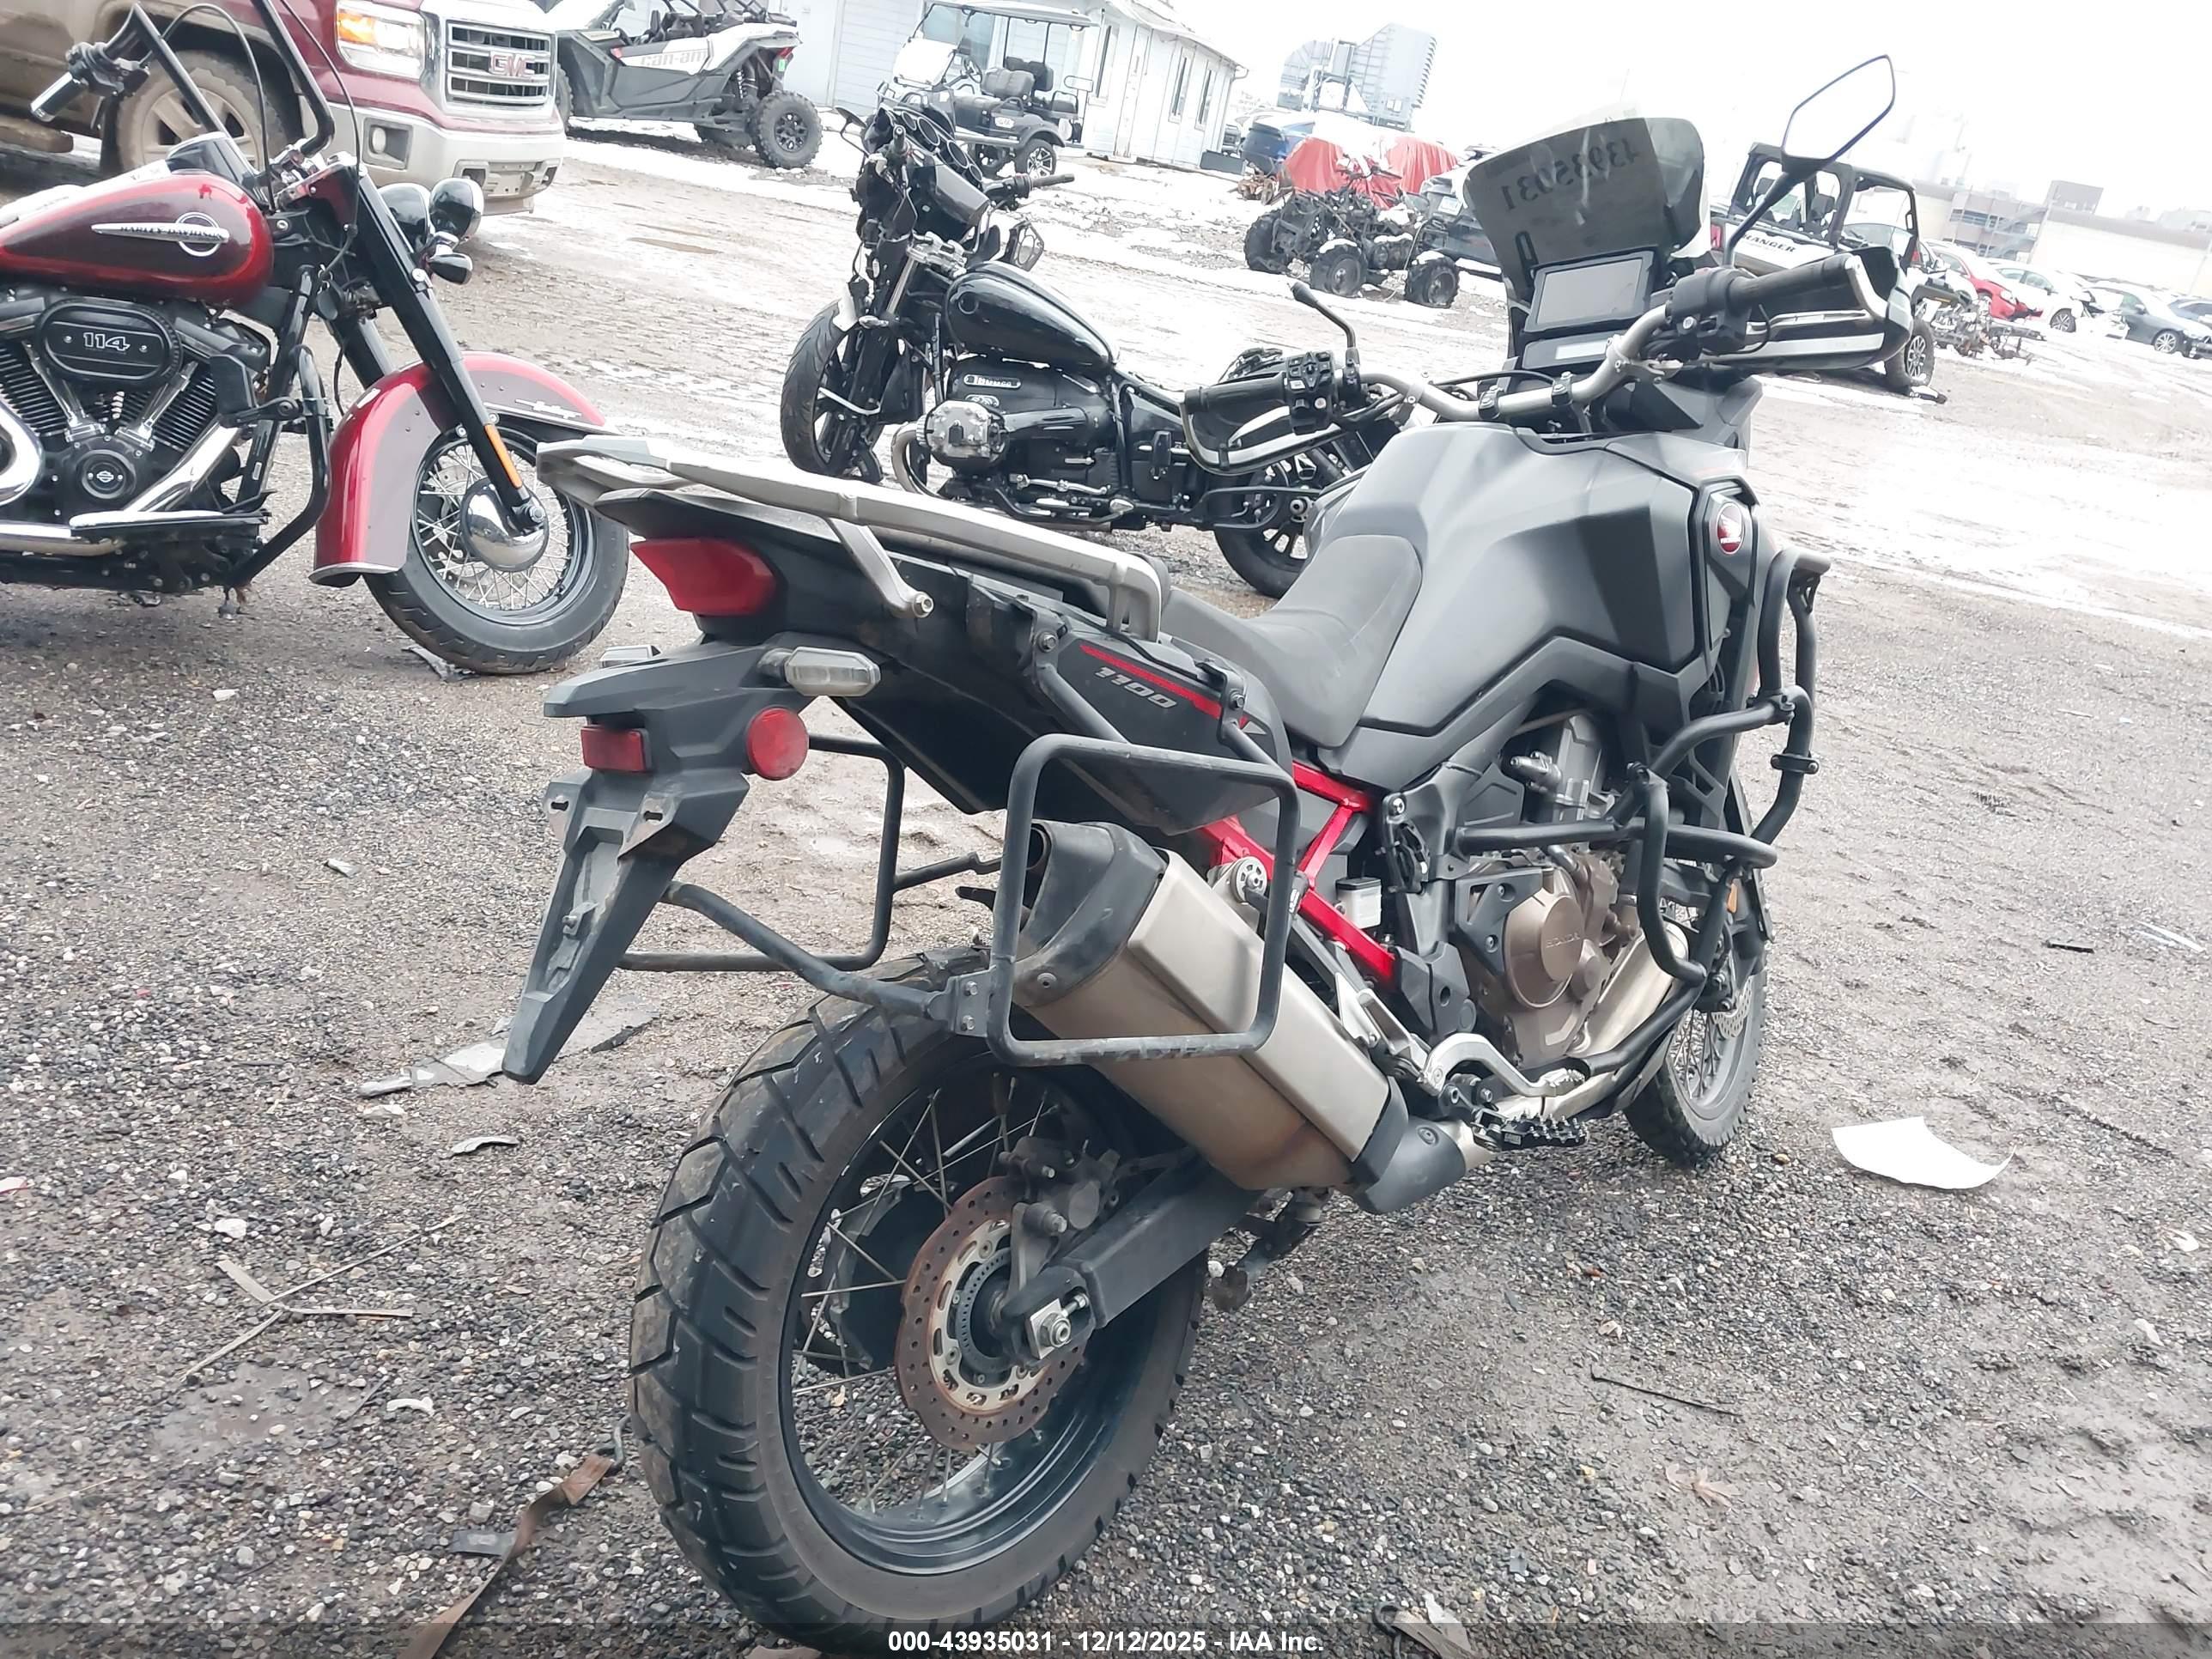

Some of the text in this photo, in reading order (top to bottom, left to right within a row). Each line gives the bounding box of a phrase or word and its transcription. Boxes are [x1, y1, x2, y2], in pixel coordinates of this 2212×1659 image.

[489, 53, 536, 77] GMC
[641, 49, 708, 67] can-am
[82, 331, 131, 352] 114
[1095, 666, 1177, 709] 1100
